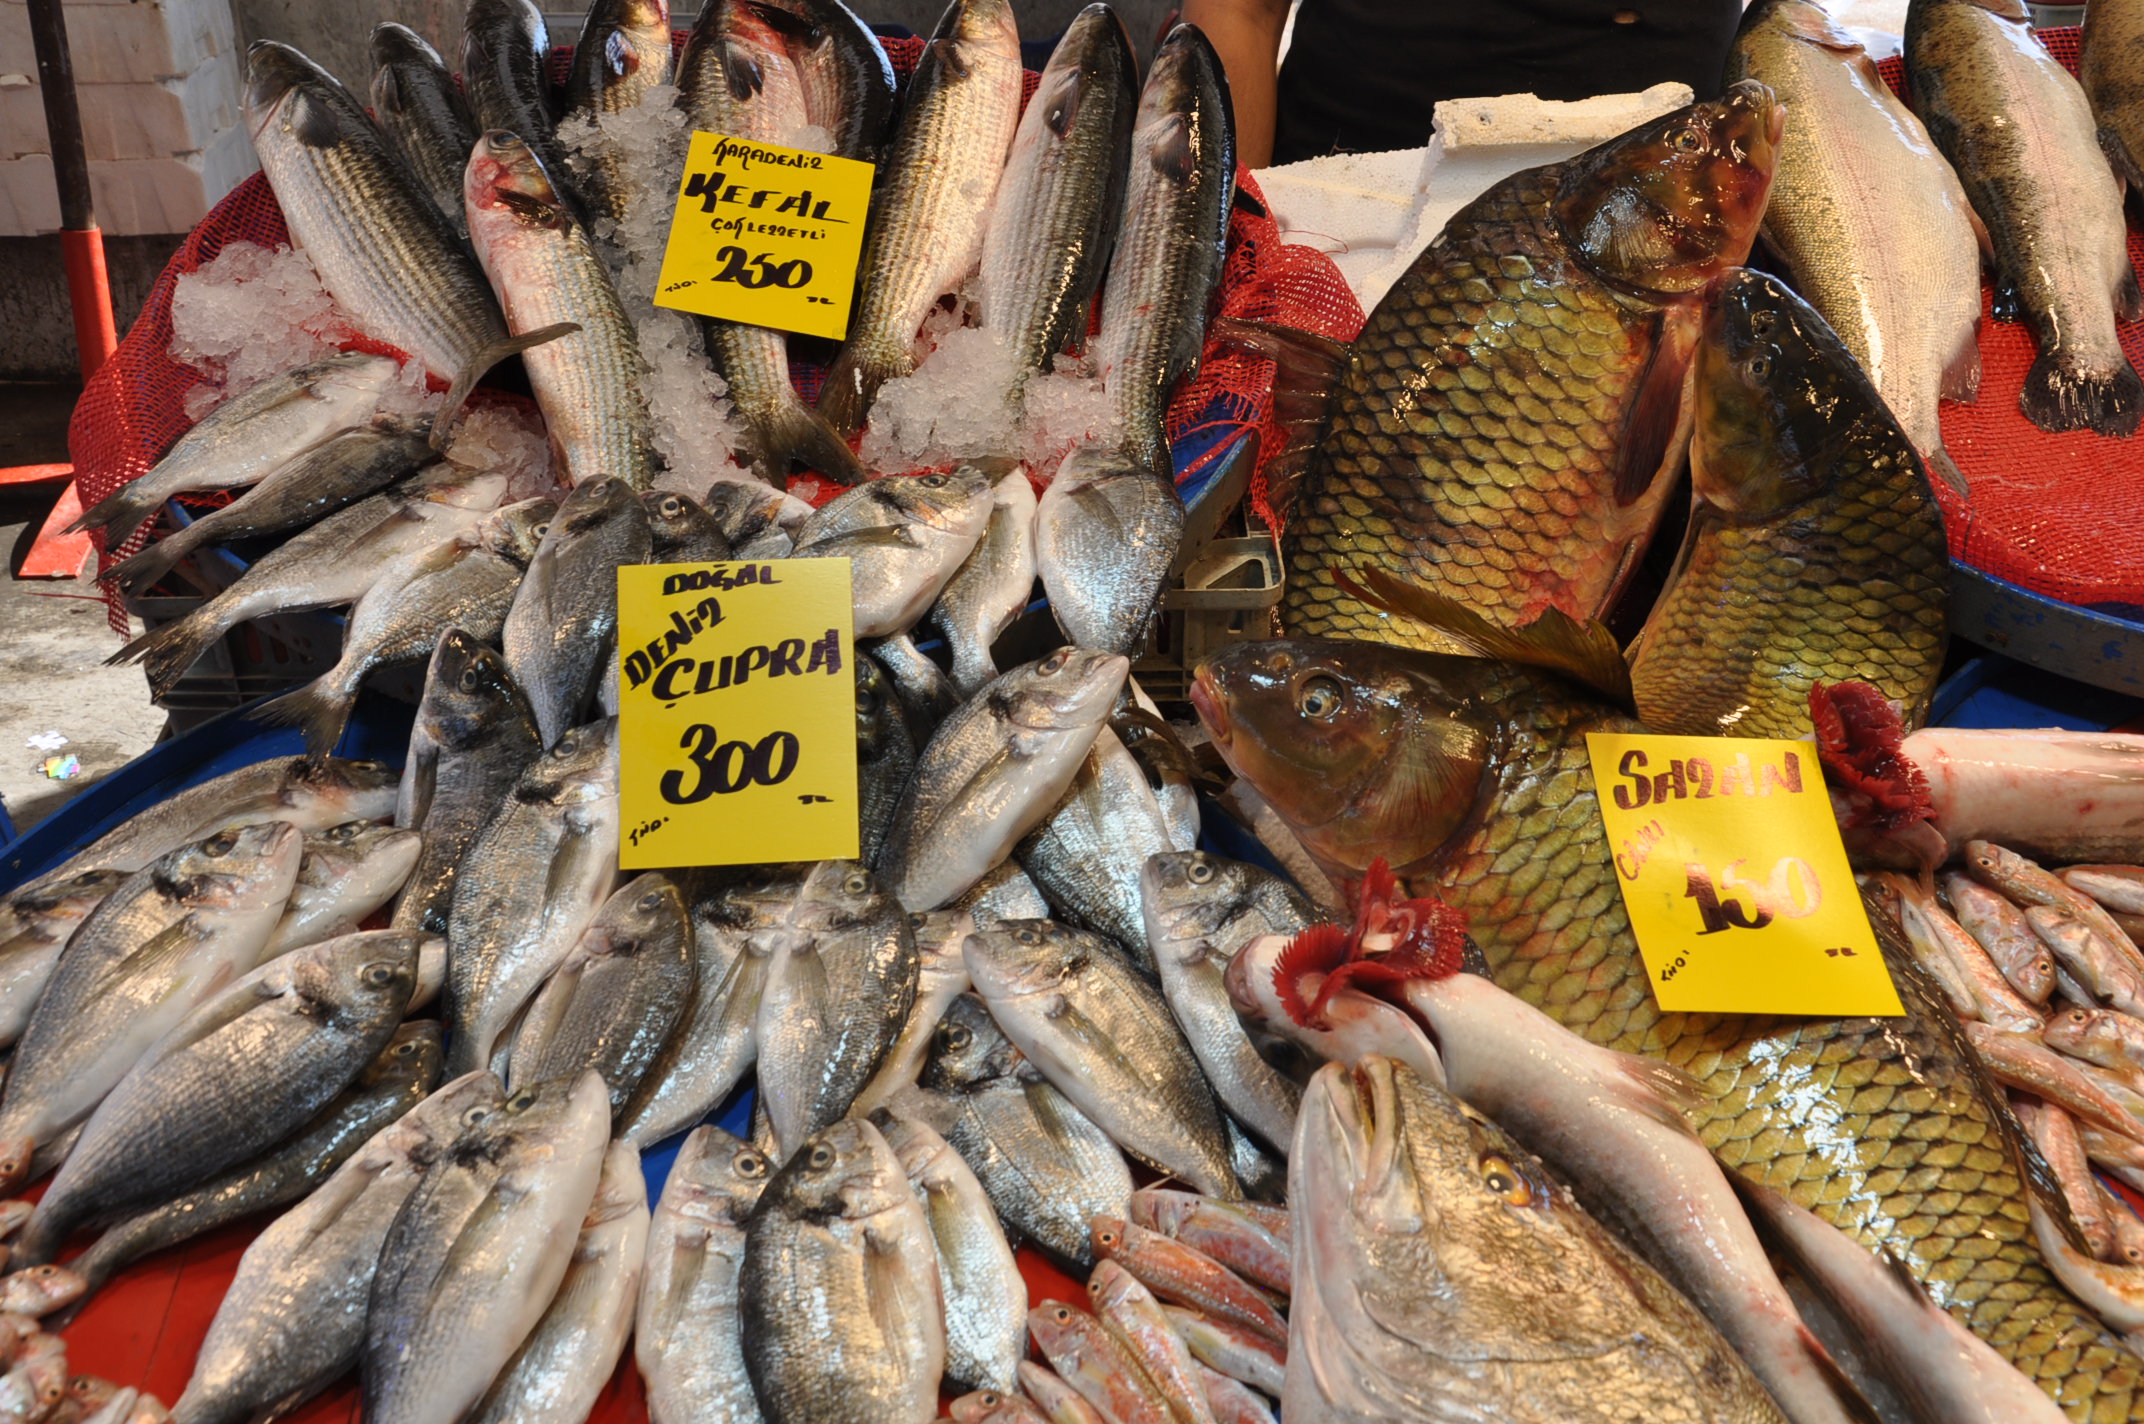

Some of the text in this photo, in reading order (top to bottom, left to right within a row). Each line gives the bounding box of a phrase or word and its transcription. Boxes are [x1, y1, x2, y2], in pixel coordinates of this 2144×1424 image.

[684, 172, 850, 223] KEFAL
[710, 246, 813, 289] 250
[662, 564, 783, 595] DOĞAL
[652, 629, 842, 709] ÇUPRA
[660, 723, 799, 805] 300
[1613, 750, 1803, 810] SAZAN
[1684, 857, 1822, 935] 150
